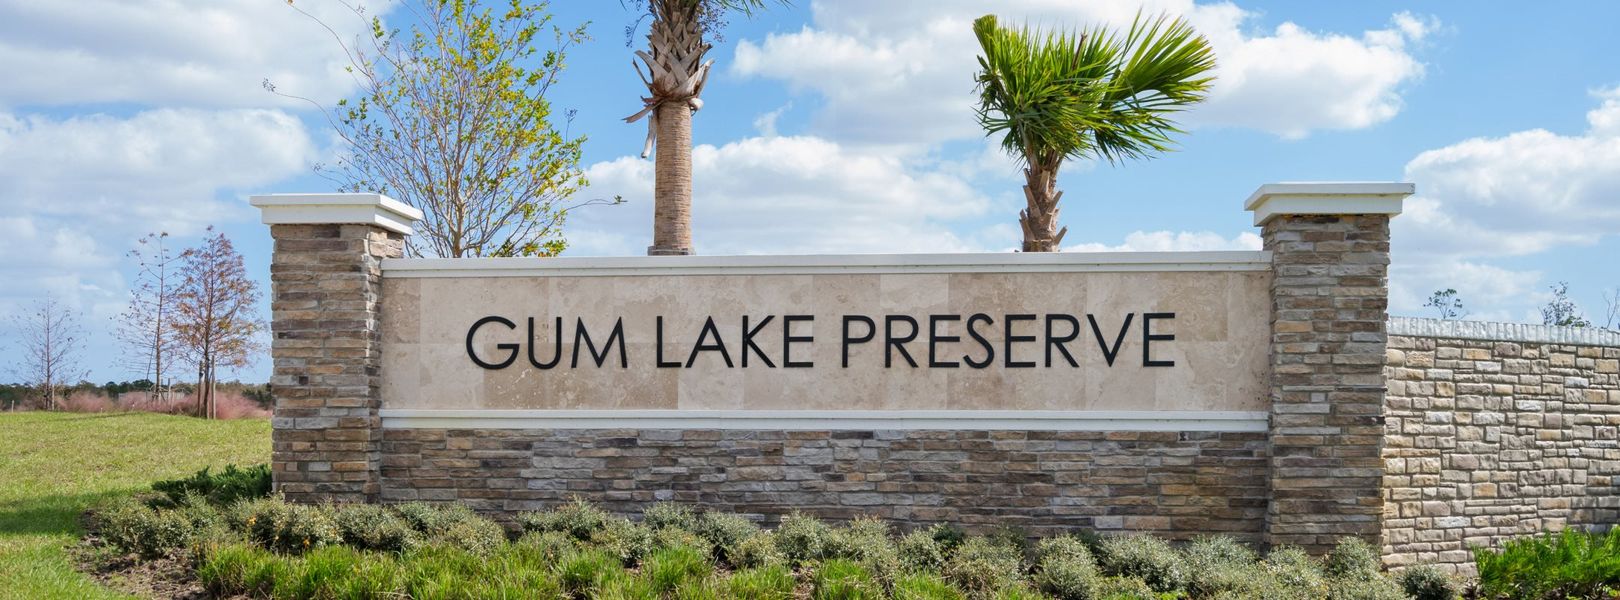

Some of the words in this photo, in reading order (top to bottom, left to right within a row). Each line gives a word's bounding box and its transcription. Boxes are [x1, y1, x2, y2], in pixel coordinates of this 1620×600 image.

[465, 315, 628, 371] GUM
[656, 314, 815, 369] LAKE
[841, 312, 1177, 370] PRESERVE
